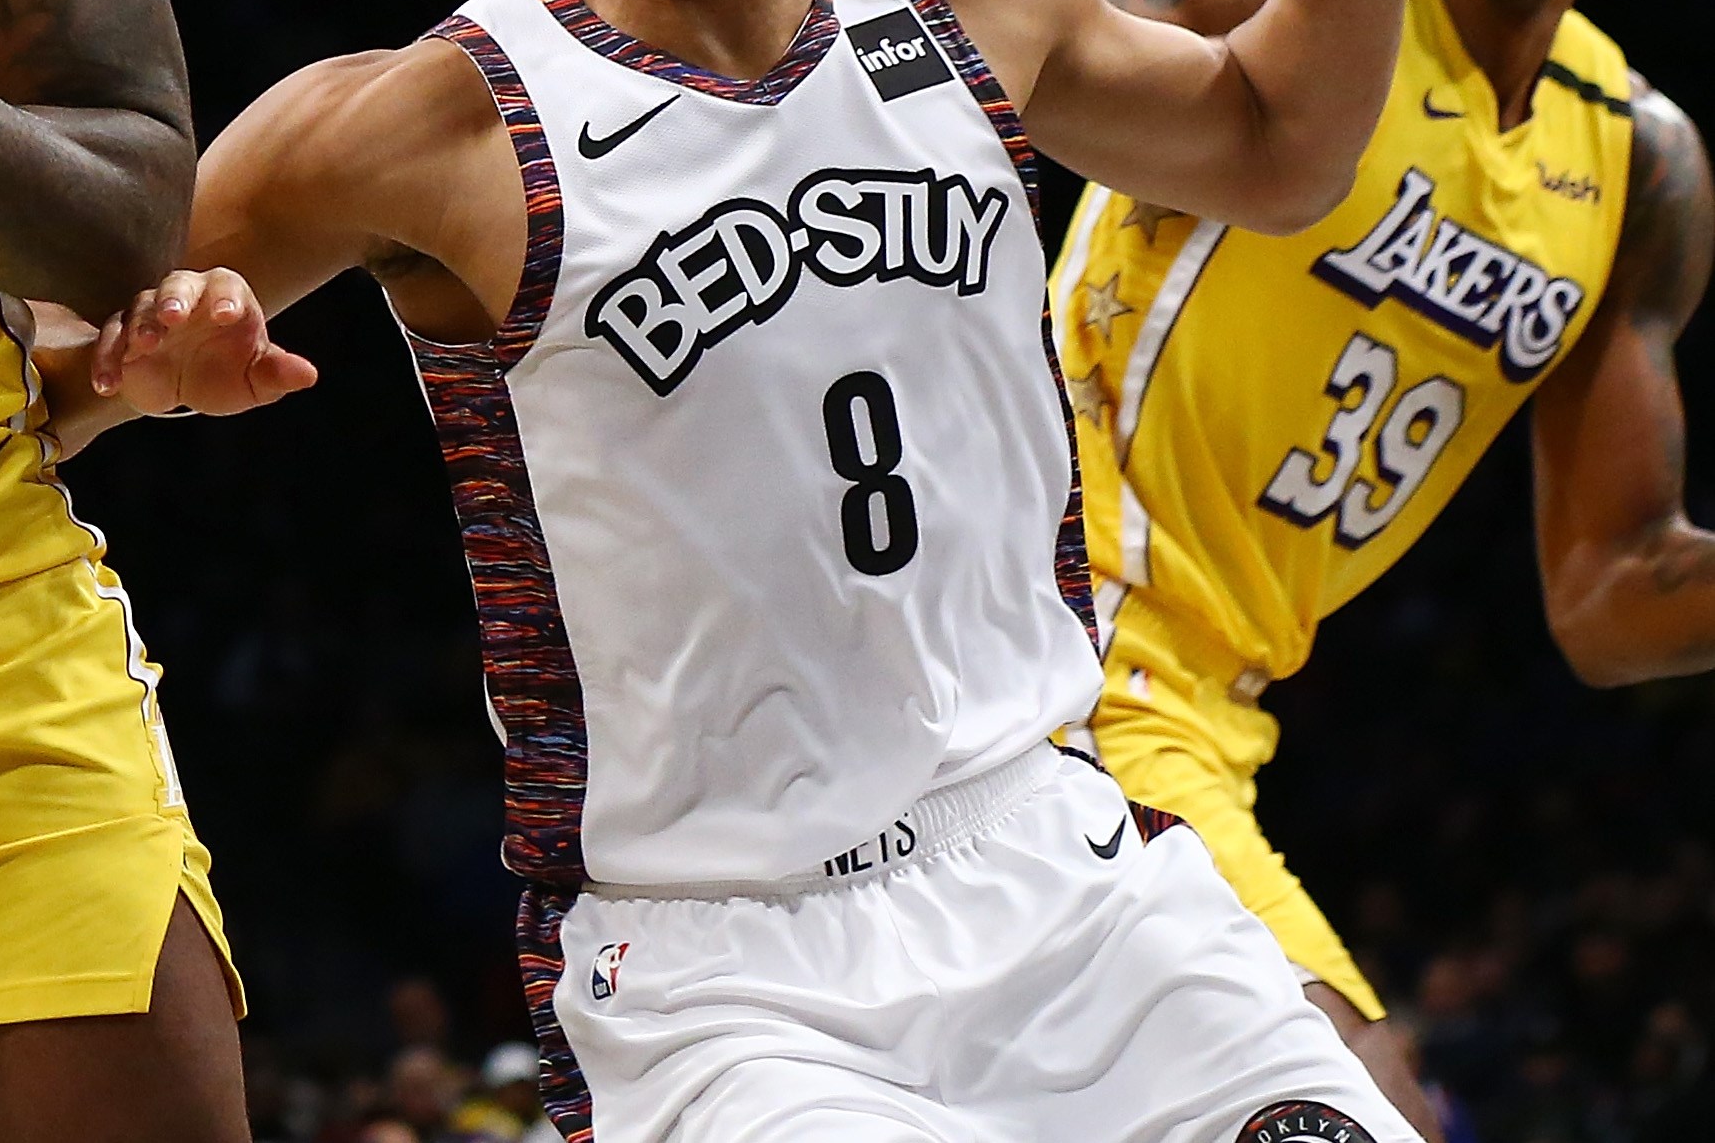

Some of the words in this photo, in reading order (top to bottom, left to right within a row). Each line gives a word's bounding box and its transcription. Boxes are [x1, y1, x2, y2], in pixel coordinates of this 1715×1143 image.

[857, 34, 928, 75] infor
[584, 167, 1007, 397] BED-STUY
[1310, 165, 1585, 385] LAKERS
[1534, 160, 1602, 205] wish
[821, 370, 919, 576] 8
[1256, 330, 1466, 550] 39
